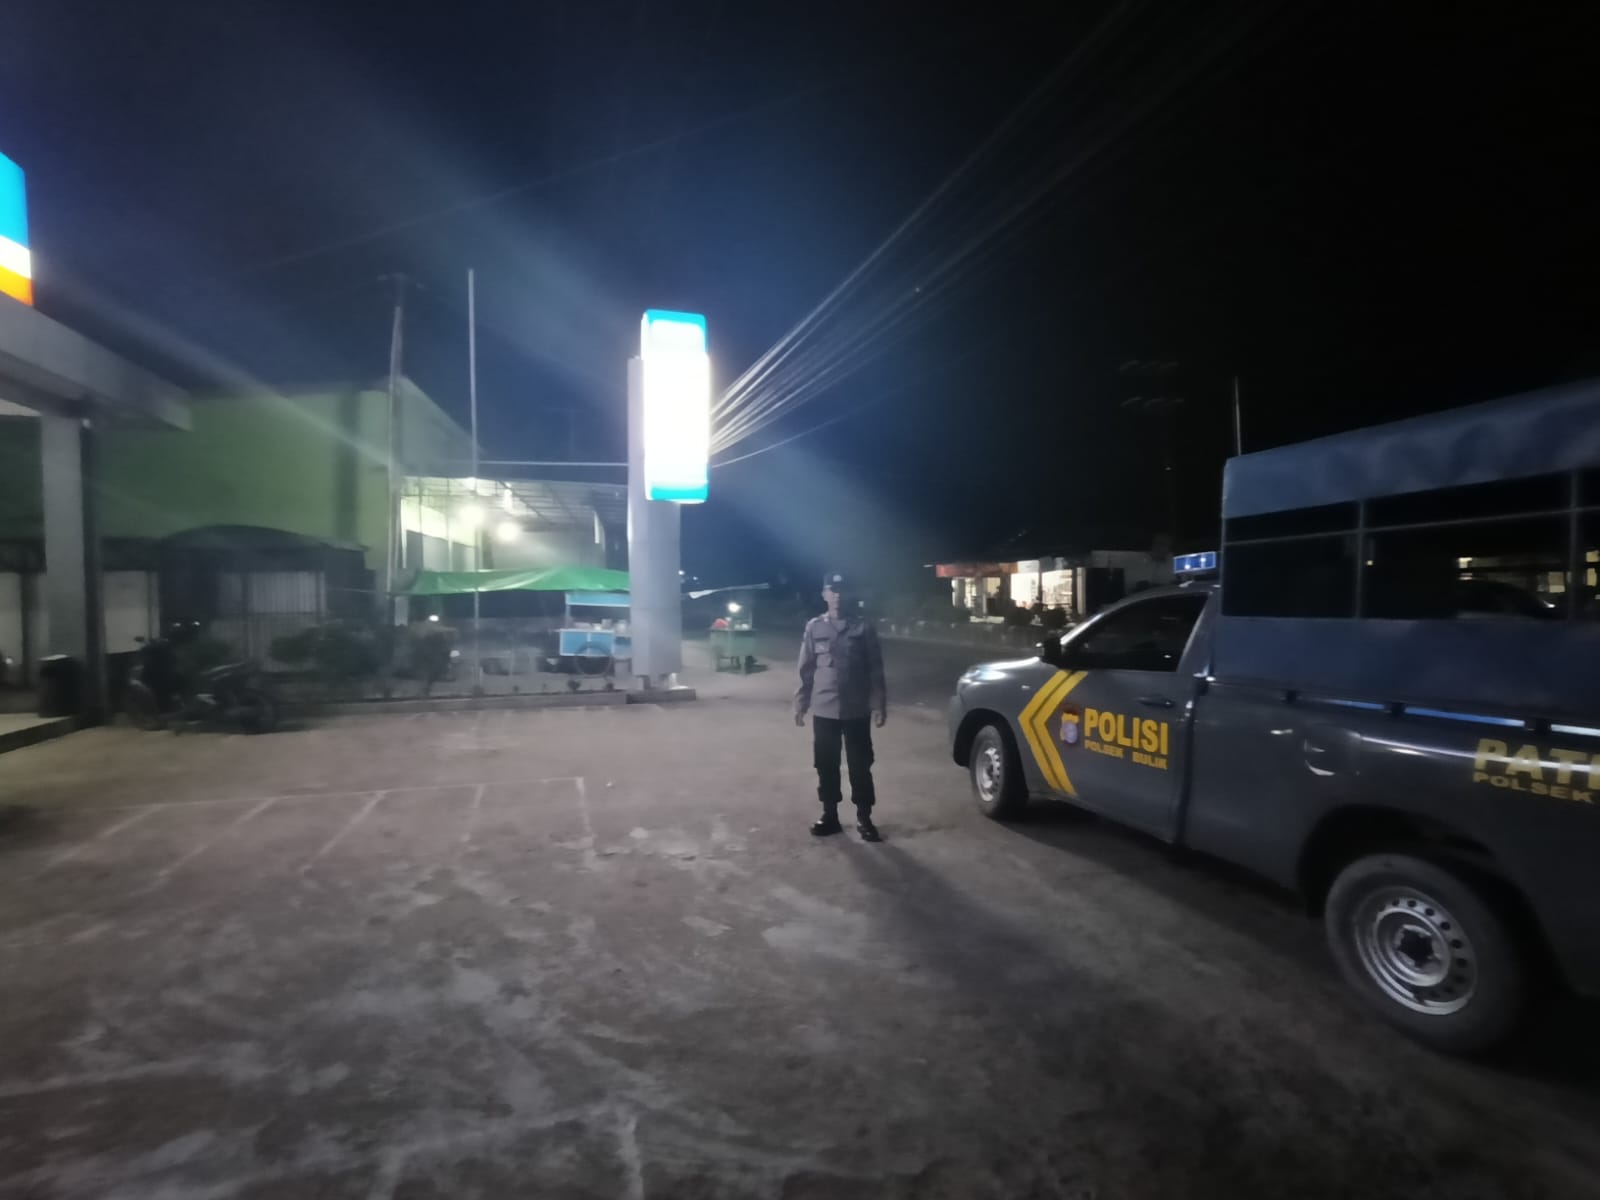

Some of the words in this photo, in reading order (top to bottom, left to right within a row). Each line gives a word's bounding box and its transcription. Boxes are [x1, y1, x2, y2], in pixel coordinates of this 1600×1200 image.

[1084, 707, 1169, 755] POLISI
[1084, 739, 1124, 759] POLSEK
[1473, 771, 1595, 804] POLSEK
